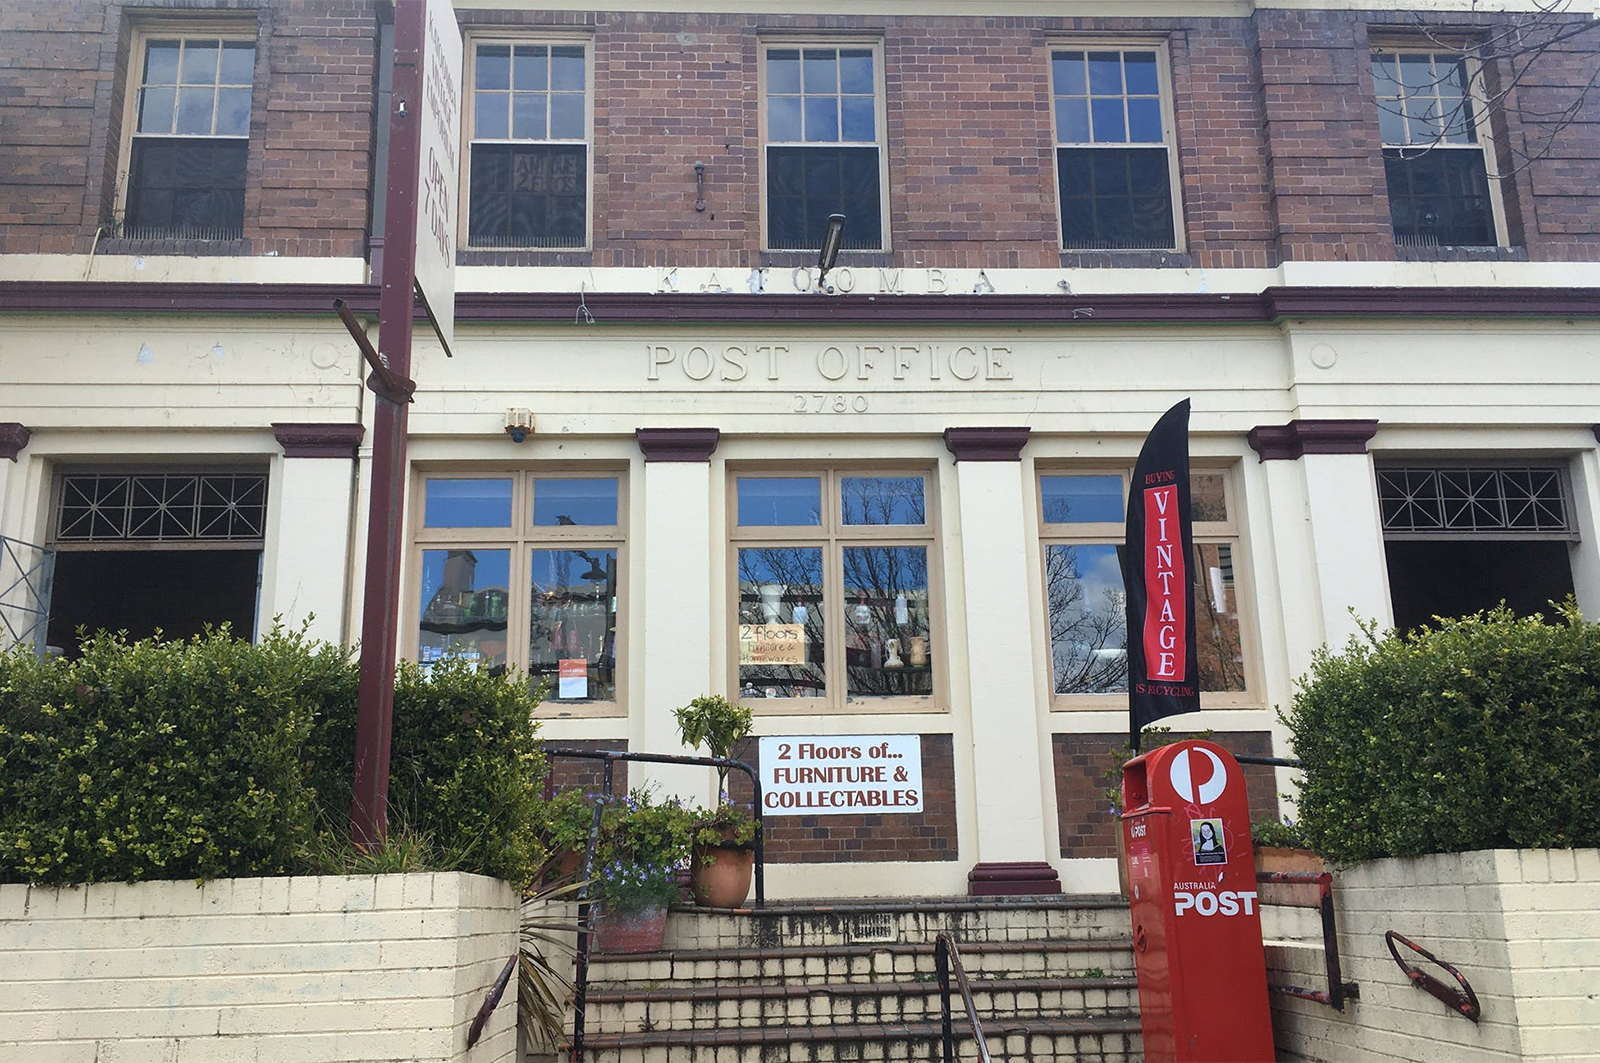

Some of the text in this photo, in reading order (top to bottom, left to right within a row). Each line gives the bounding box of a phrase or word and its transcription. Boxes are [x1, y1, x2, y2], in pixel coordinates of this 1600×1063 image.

[428, 146, 449, 223] OPEN
[424, 177, 450, 269] 7 DAYS
[646, 344, 1013, 381] POST OFFICE
[793, 394, 868, 414] 2780
[1145, 470, 1175, 485] BUYING
[1153, 490, 1176, 677] VINTAGE
[741, 625, 798, 641] 2 floors
[786, 644, 796, 652] &
[1135, 683, 1195, 697] IS RECYCLING
[777, 742, 903, 760] 2 Floors of...
[774, 765, 909, 784] FURNITURE &
[764, 789, 919, 808] COLLECTABLES
[1173, 881, 1217, 890] AUSTRALIA
[1174, 891, 1258, 916] POST
